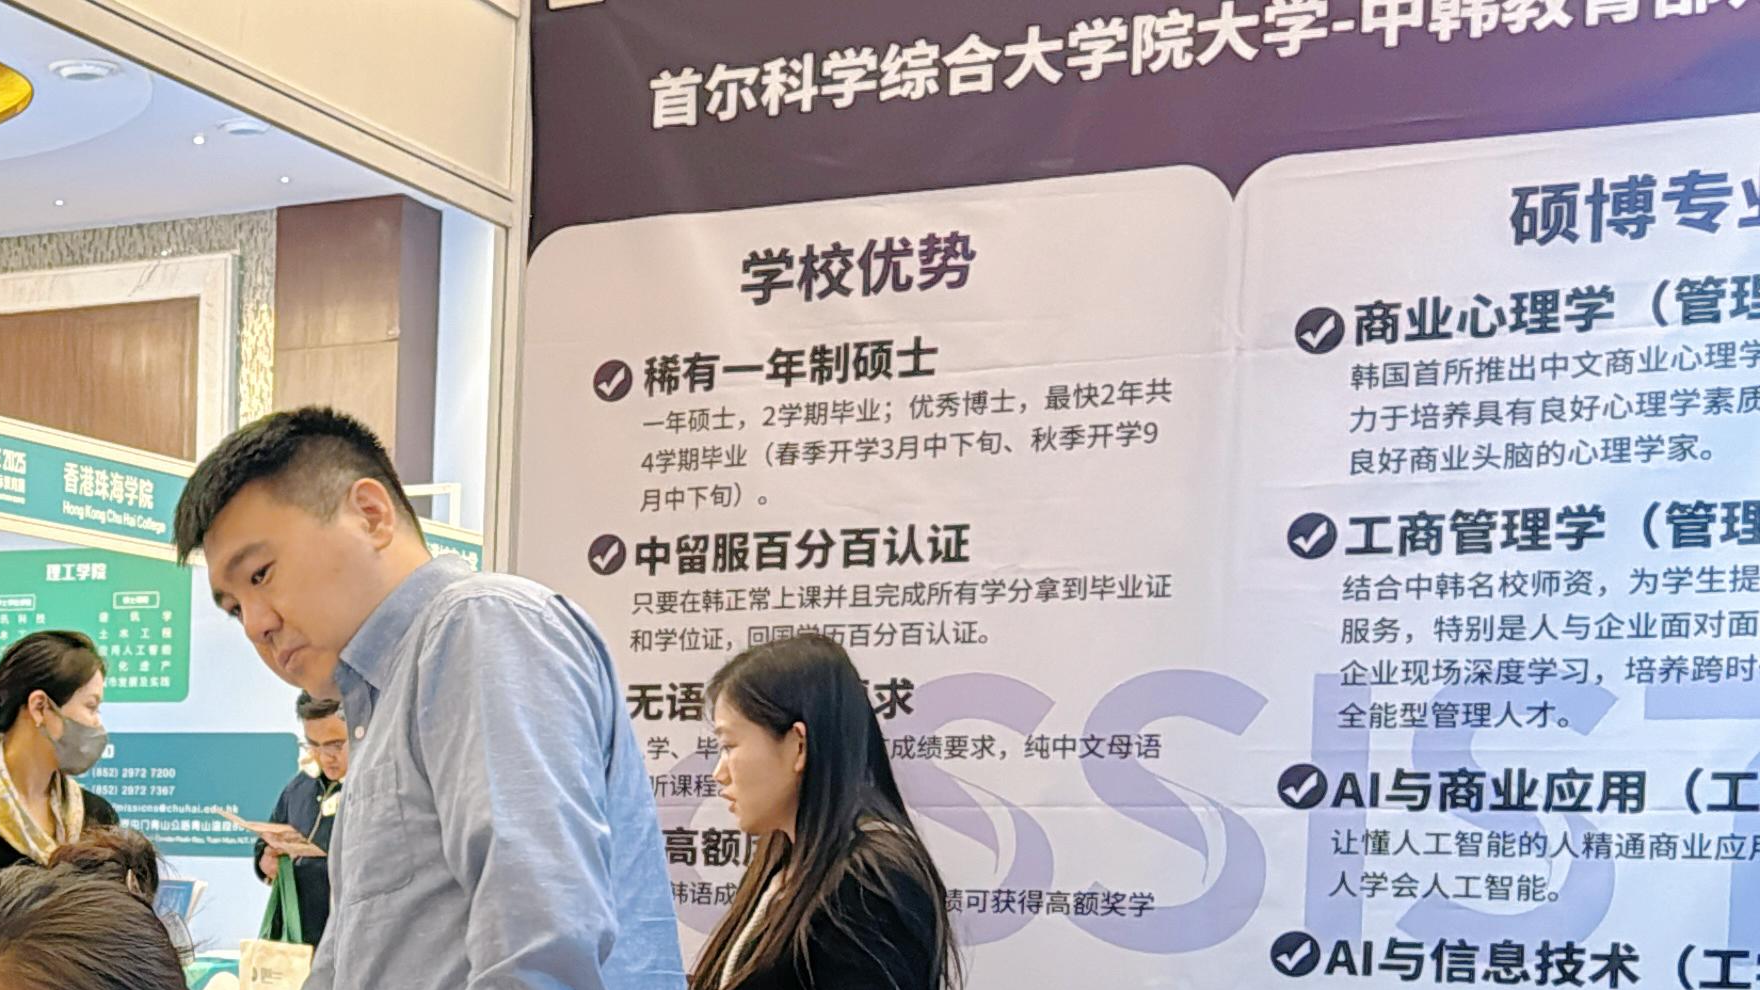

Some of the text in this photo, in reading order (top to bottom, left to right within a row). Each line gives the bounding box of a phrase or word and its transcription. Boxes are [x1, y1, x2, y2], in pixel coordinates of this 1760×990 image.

[650, 0, 1747, 130] 首尔科学综合大学院大学-中韩教
[741, 230, 977, 306] 学校优势
[643, 336, 939, 398] 稀有一年制硕士
[642, 377, 1173, 433] 一年硕士，2学期毕业；优秀博士，最快2年共
[1350, 433, 1714, 476] 良好商业头脑的心理学家。
[63, 462, 154, 510] 香港珠海学院
[640, 483, 770, 513] 月中下旬）。
[63, 500, 84, 520] Hong
[85, 505, 106, 524] Kong
[636, 523, 971, 576] 中留服百分百认证
[45, 563, 107, 582] 理工学院
[631, 574, 1173, 615] 只要在韩正常上课并且完成所有学分拿到毕业证
[1341, 608, 1759, 645] 服务，特别是人与企业面对面
[1339, 654, 1760, 688] 企业现场深度学习，培养跨时
[1338, 699, 1574, 730] 全能型管理人才。
[122, 768, 147, 779] 2972
[151, 768, 176, 779] 7200
[1329, 871, 1561, 904] 人学会人工智能。
[1324, 936, 1760, 990] AI与信息技术（工
